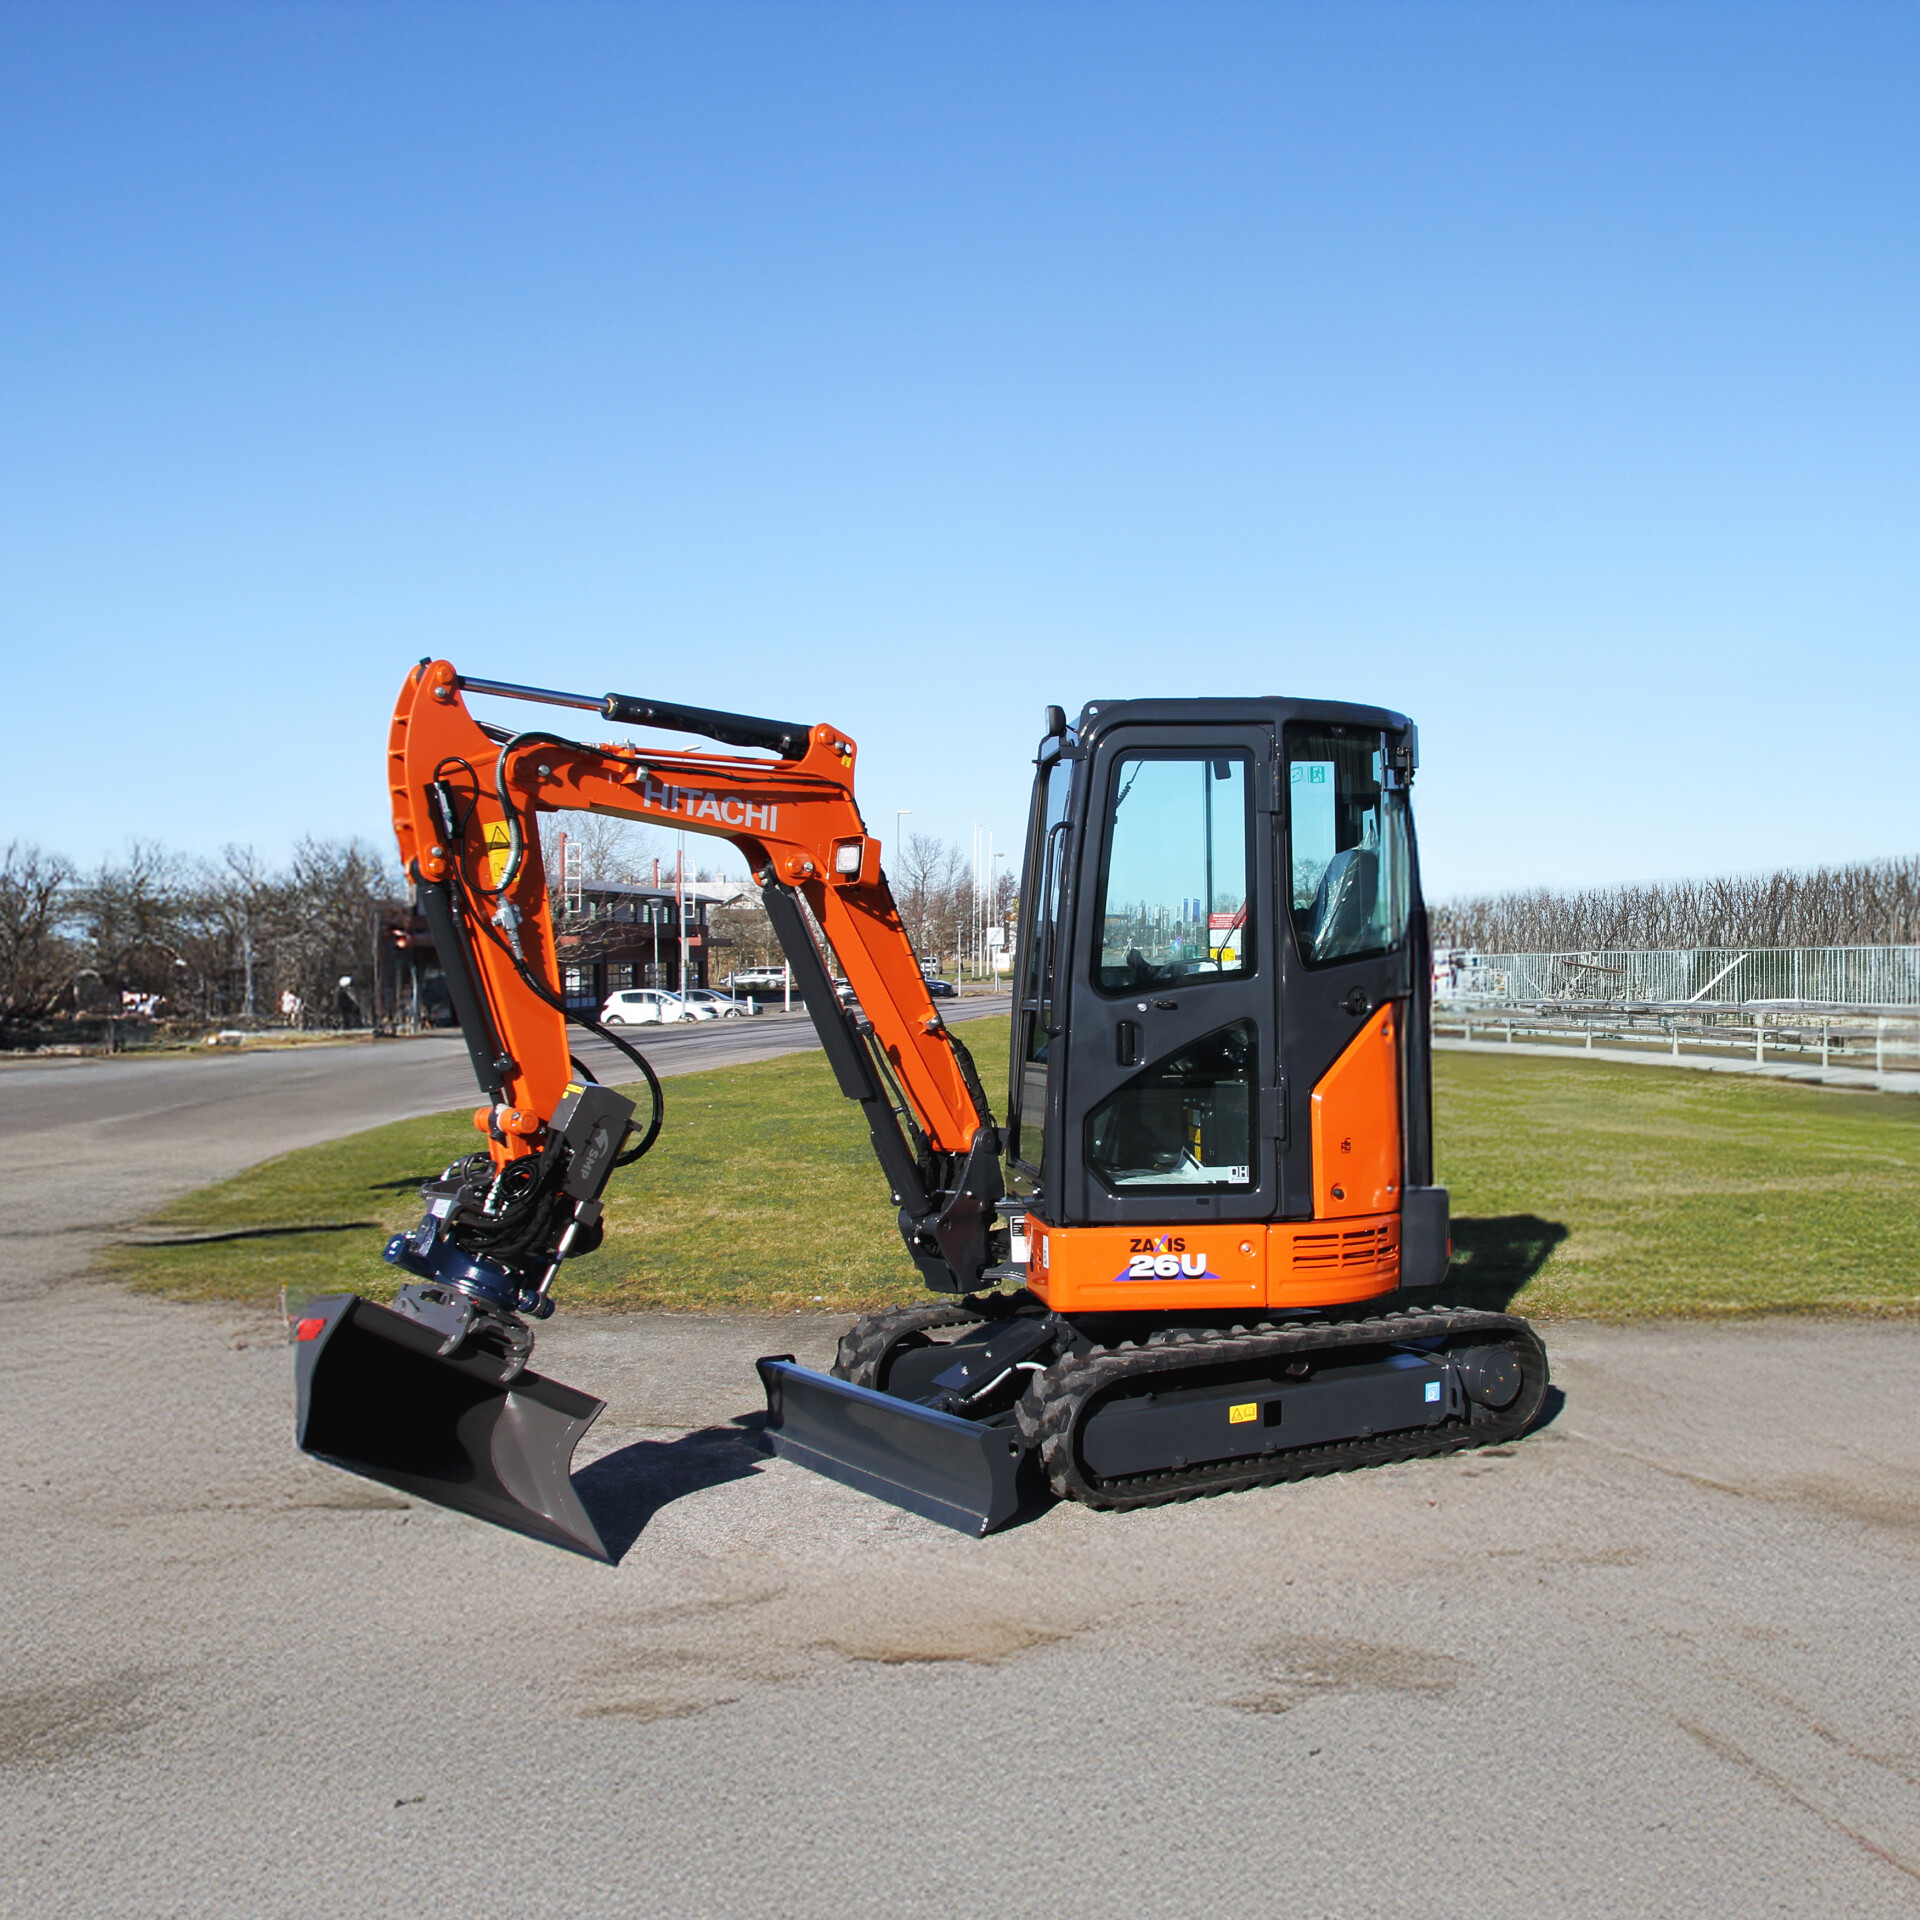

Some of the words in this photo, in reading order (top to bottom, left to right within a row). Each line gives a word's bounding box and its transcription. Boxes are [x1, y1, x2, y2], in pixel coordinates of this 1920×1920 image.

[643, 780, 778, 832] HITACHI
[580, 1148, 599, 1179] SMP
[1130, 1234, 1186, 1252] ZAXIS
[1128, 1253, 1207, 1280] 26U
